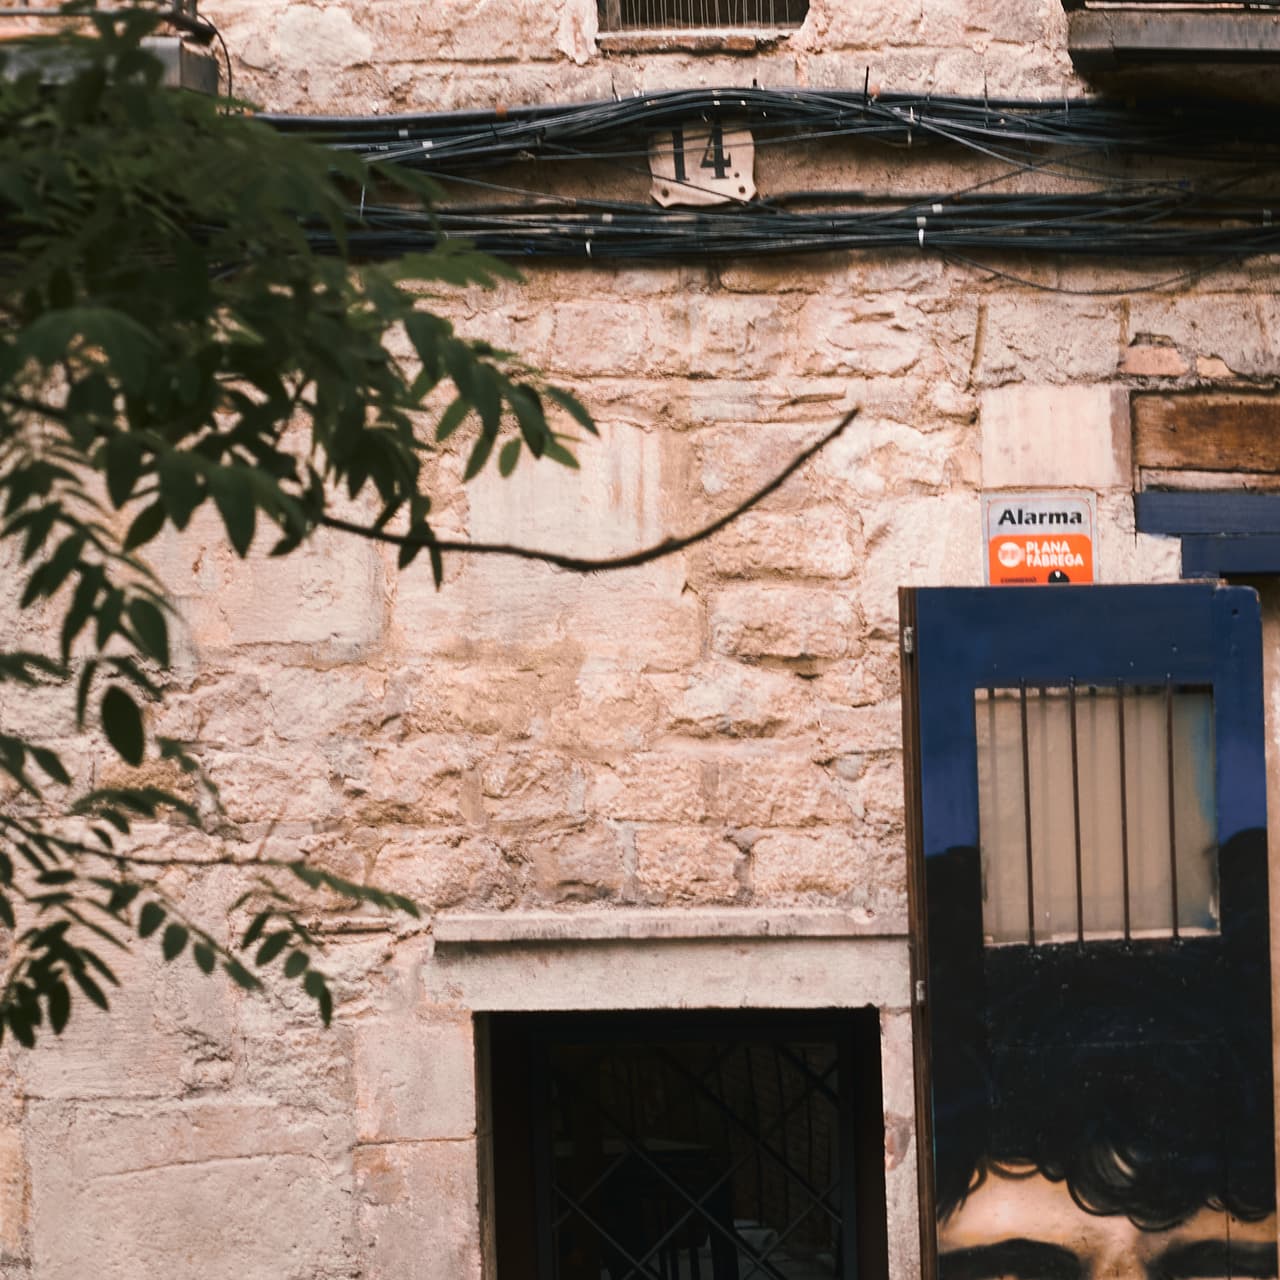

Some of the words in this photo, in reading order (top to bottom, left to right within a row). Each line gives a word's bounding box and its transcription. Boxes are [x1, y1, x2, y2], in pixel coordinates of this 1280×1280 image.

[671, 122, 732, 182] 14
[998, 508, 1082, 525] Alarma
[1026, 541, 1071, 554] PLANA
